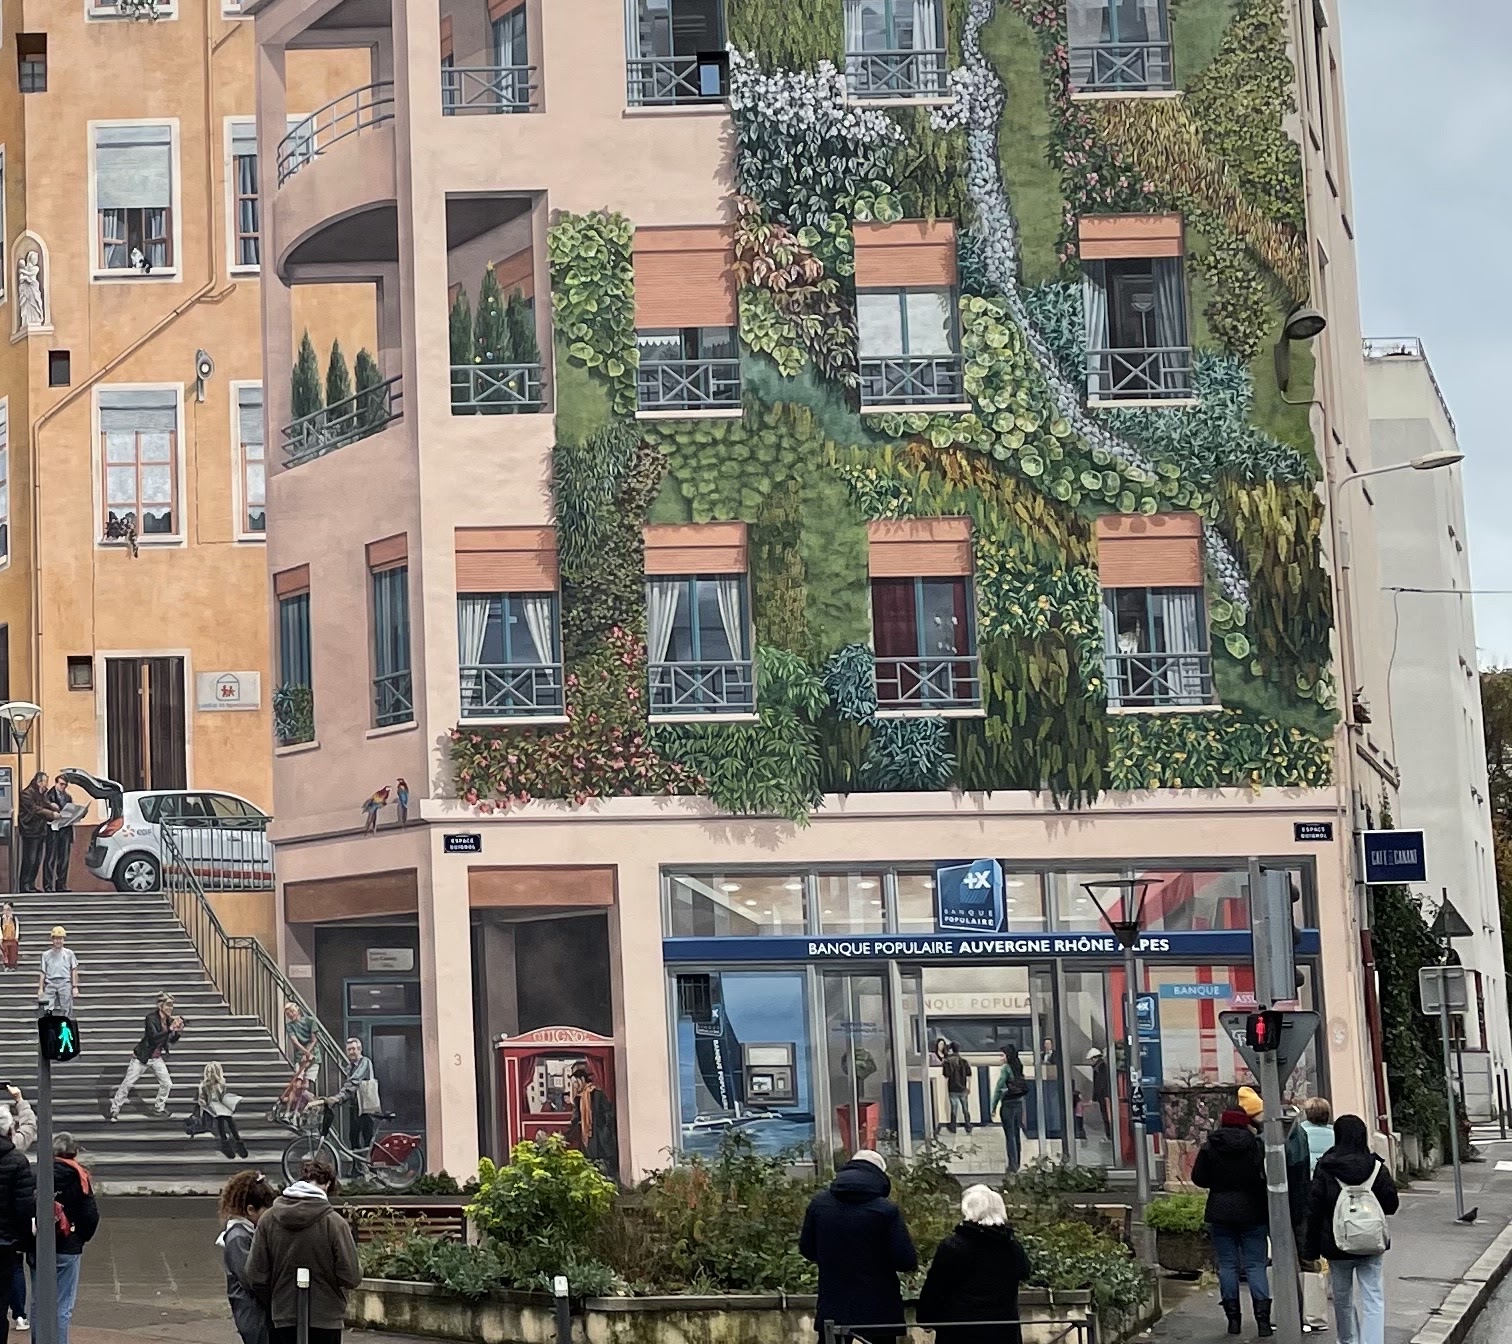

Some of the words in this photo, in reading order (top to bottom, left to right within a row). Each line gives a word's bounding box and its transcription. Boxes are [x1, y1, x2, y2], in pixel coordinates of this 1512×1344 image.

[943, 908, 994, 917] BANQUE
[944, 916, 995, 927] POPULAIRE
[808, 941, 871, 957] BANQUE
[874, 940, 954, 956] POPULAIRE
[958, 939, 1051, 954] AUVERGNE
[1054, 936, 1115, 953] RHÔNE
[1173, 985, 1221, 996] BANQUE
[453, 1053, 462, 1066] 3
